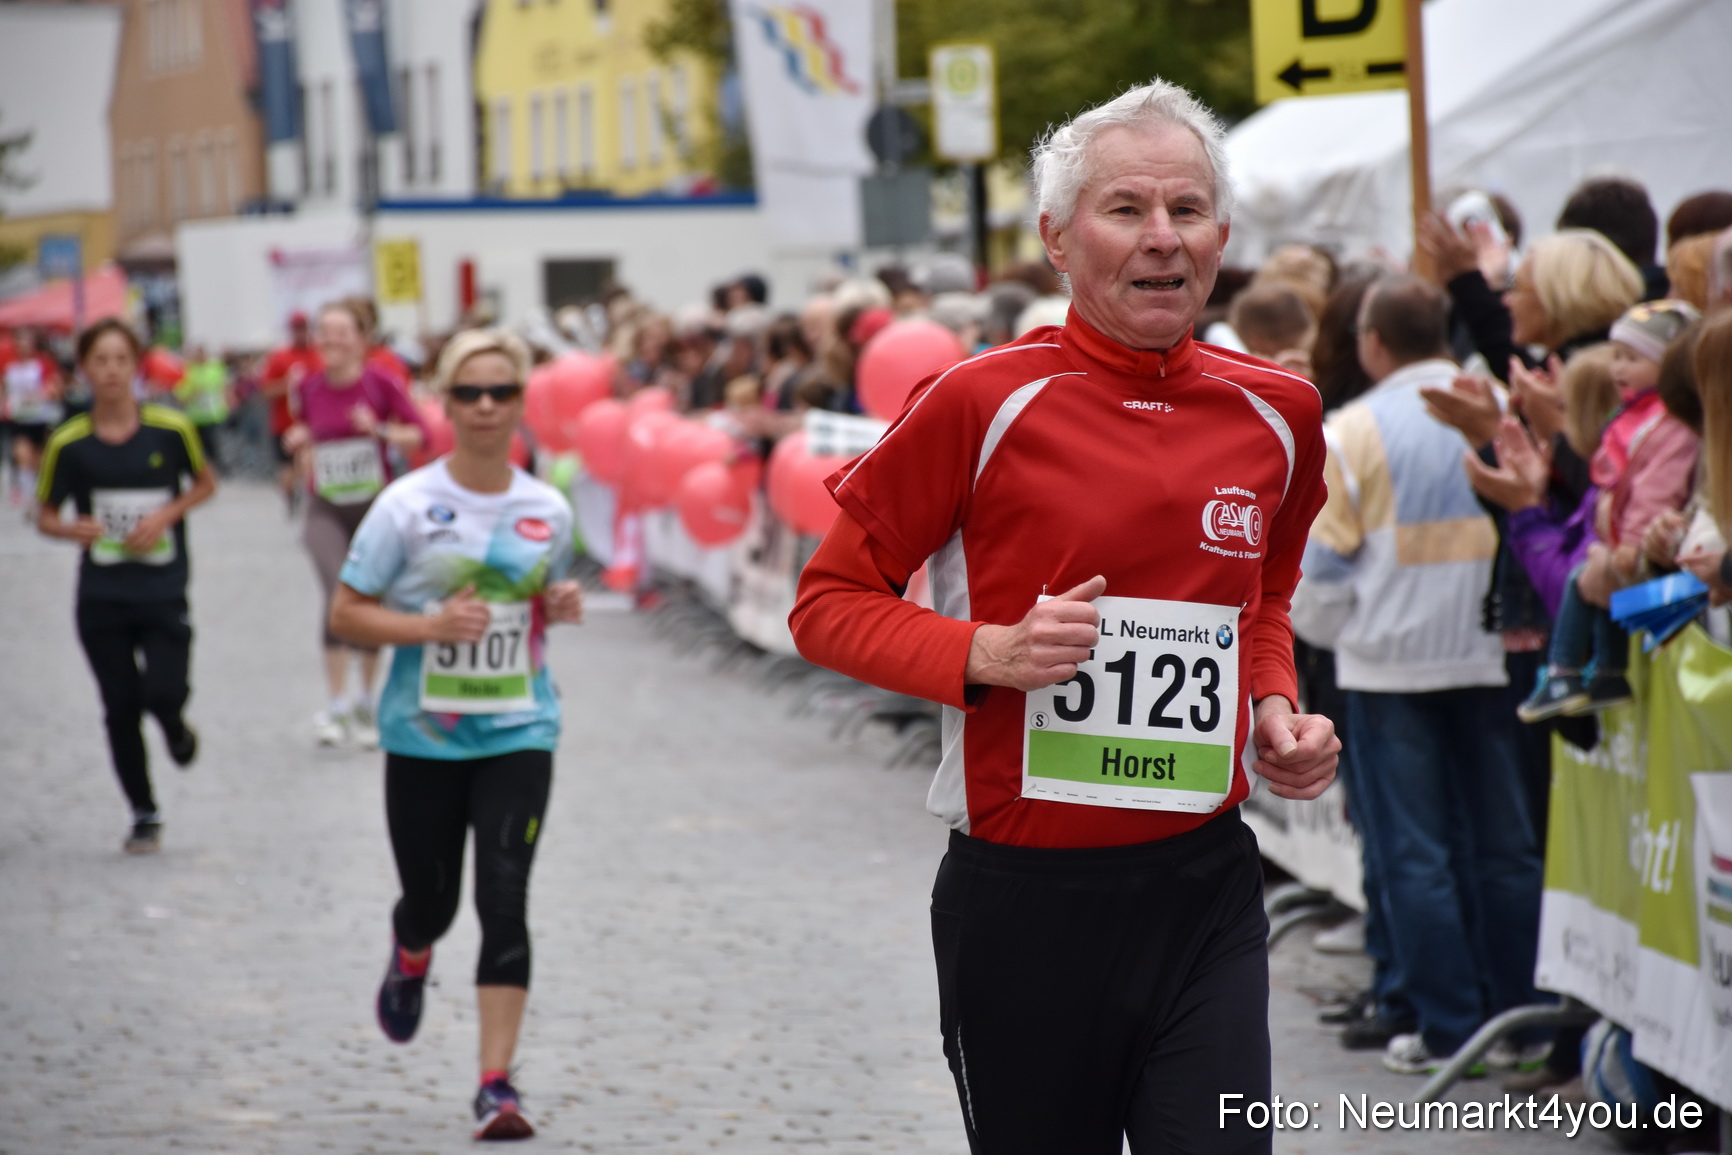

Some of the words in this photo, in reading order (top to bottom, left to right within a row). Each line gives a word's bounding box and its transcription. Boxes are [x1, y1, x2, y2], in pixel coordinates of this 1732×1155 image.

[1122, 400, 1164, 411] CRAFT
[1214, 486, 1257, 500] Laufteam
[1219, 528, 1245, 538] NEUMARKT
[1199, 541, 1238, 557] Kraftsport
[1238, 550, 1244, 558] &
[1120, 620, 1210, 645] Neumarkt
[437, 629, 521, 671] 5107
[1053, 648, 1221, 733] 5123
[1035, 714, 1044, 728] S
[1101, 747, 1176, 781] Horst
